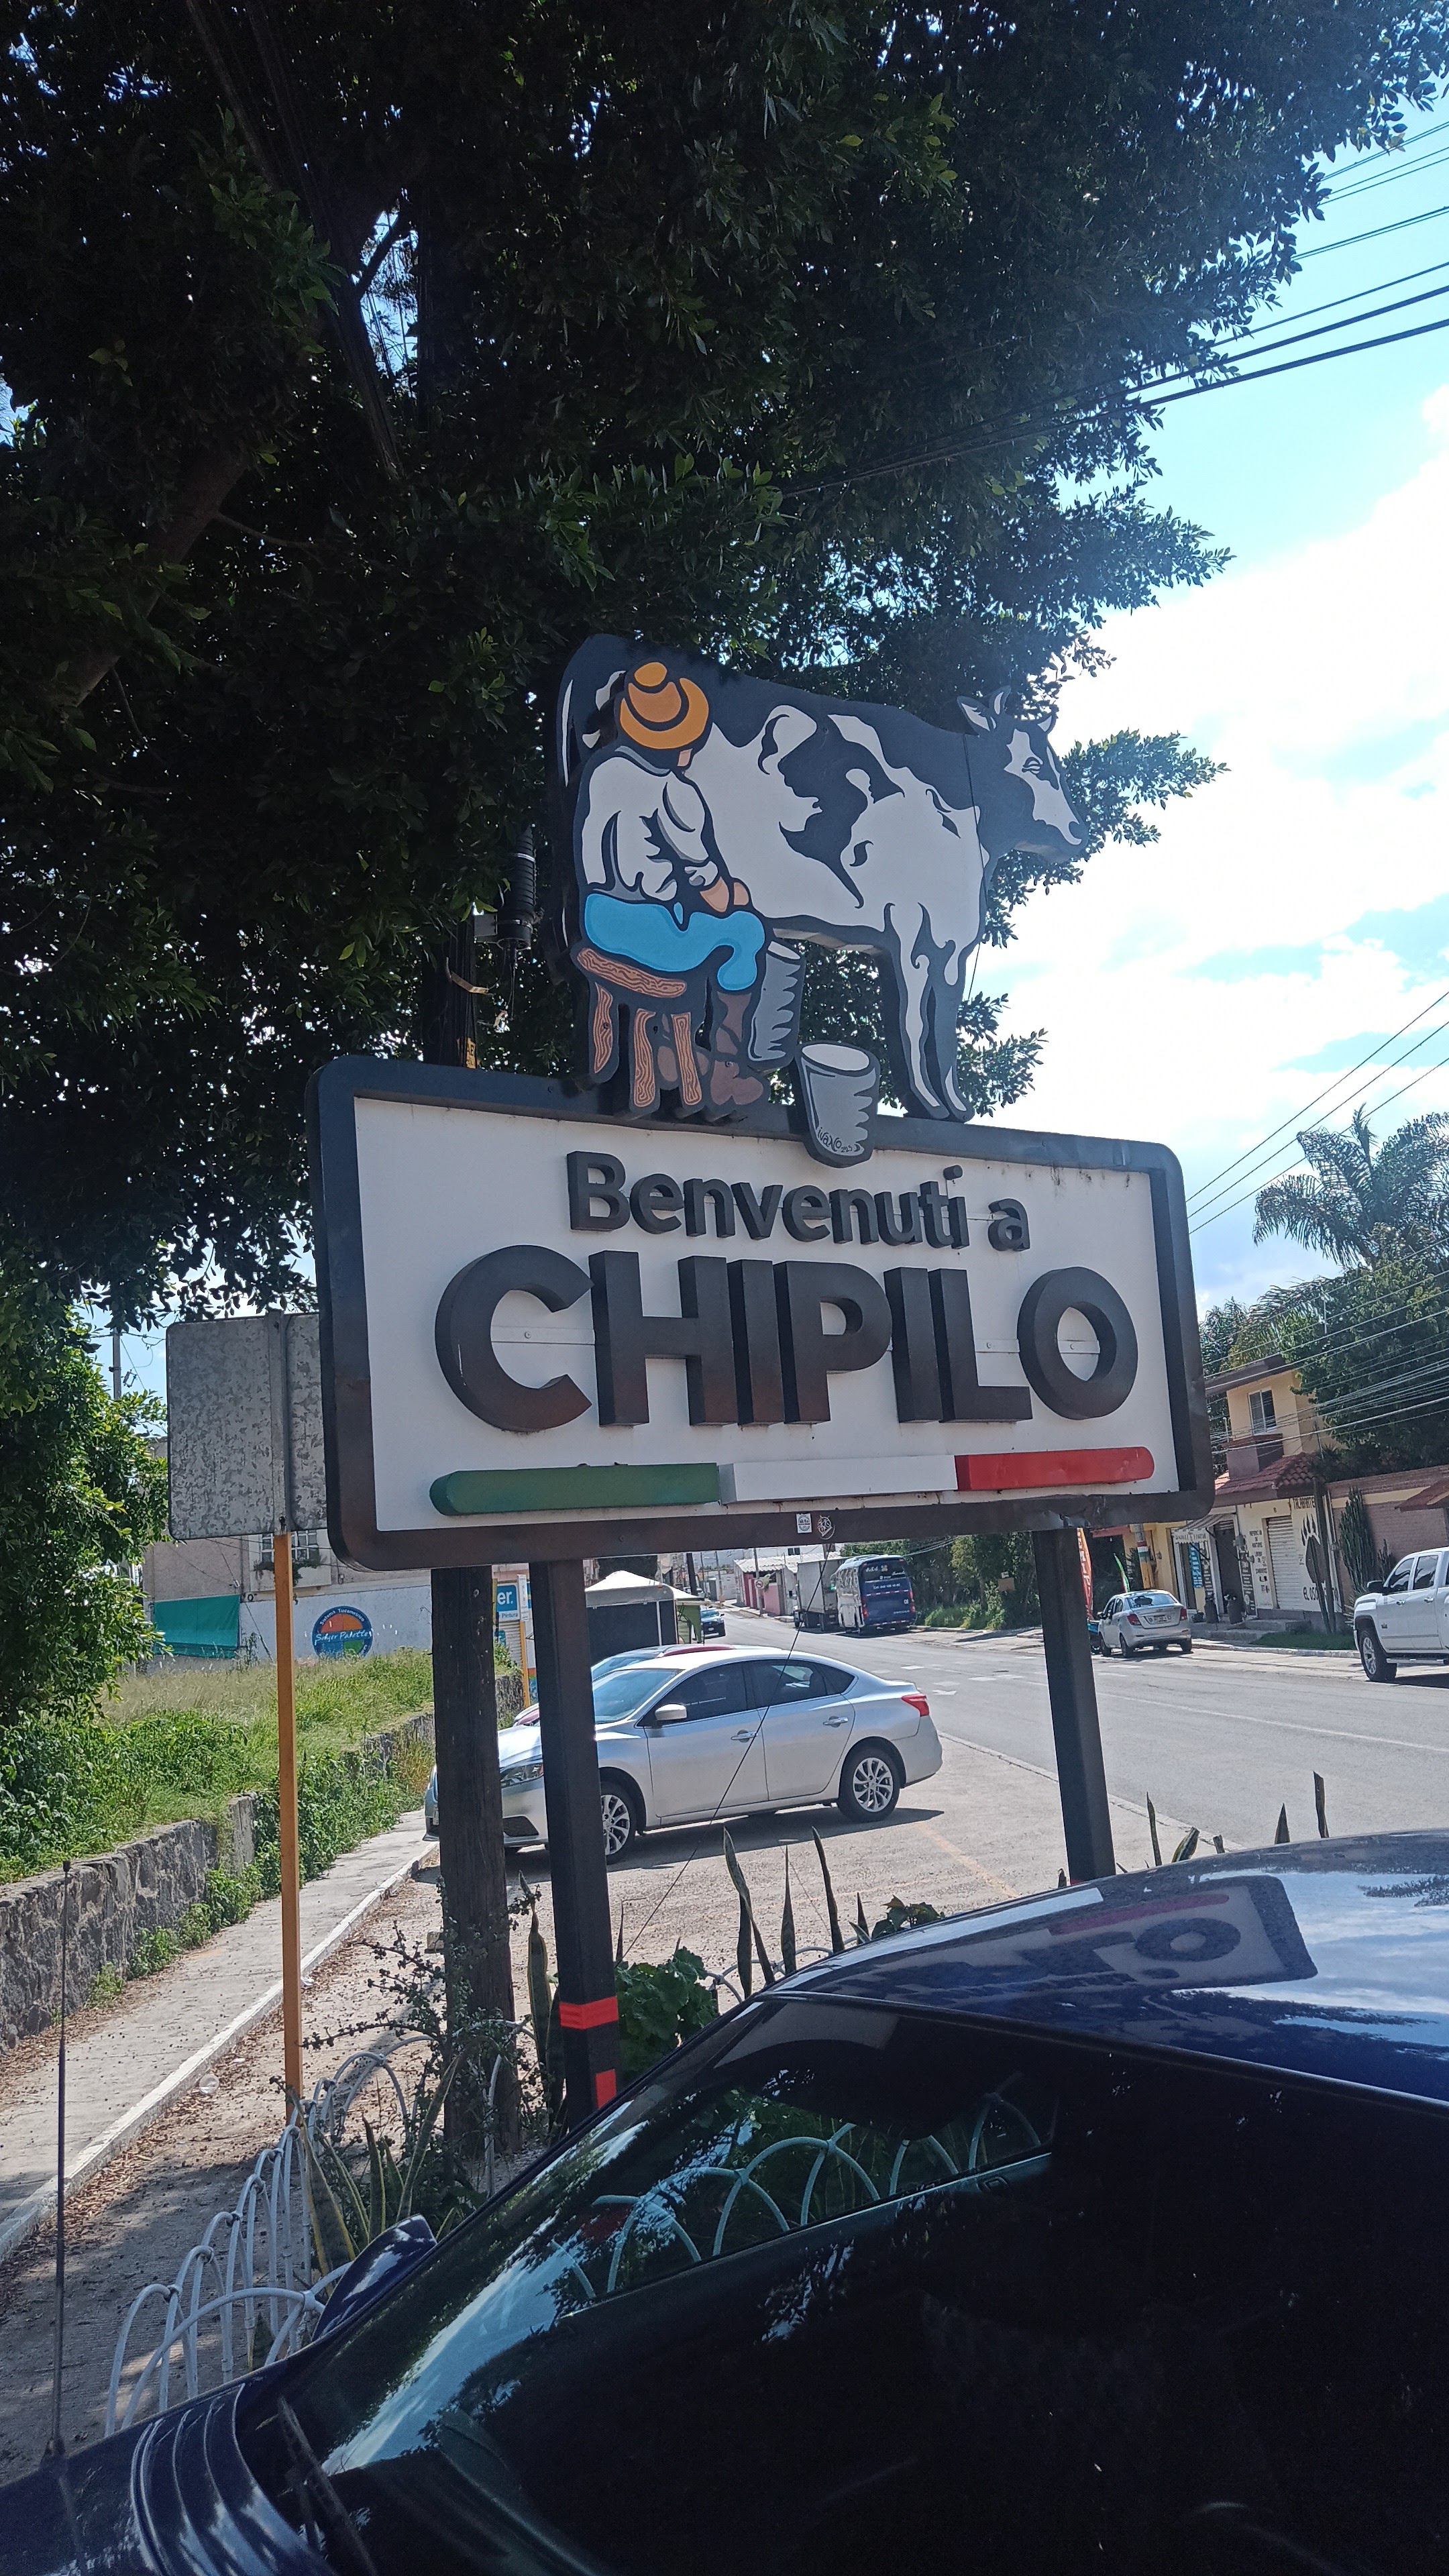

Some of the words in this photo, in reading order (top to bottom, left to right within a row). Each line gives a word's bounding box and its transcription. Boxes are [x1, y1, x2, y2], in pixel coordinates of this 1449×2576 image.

[566, 1150, 969, 1248] Benvenuti
[987, 1198, 1030, 1252] a
[435, 1244, 1139, 1433] CHIPILO
[319, 1610, 336, 1625] Sistema
